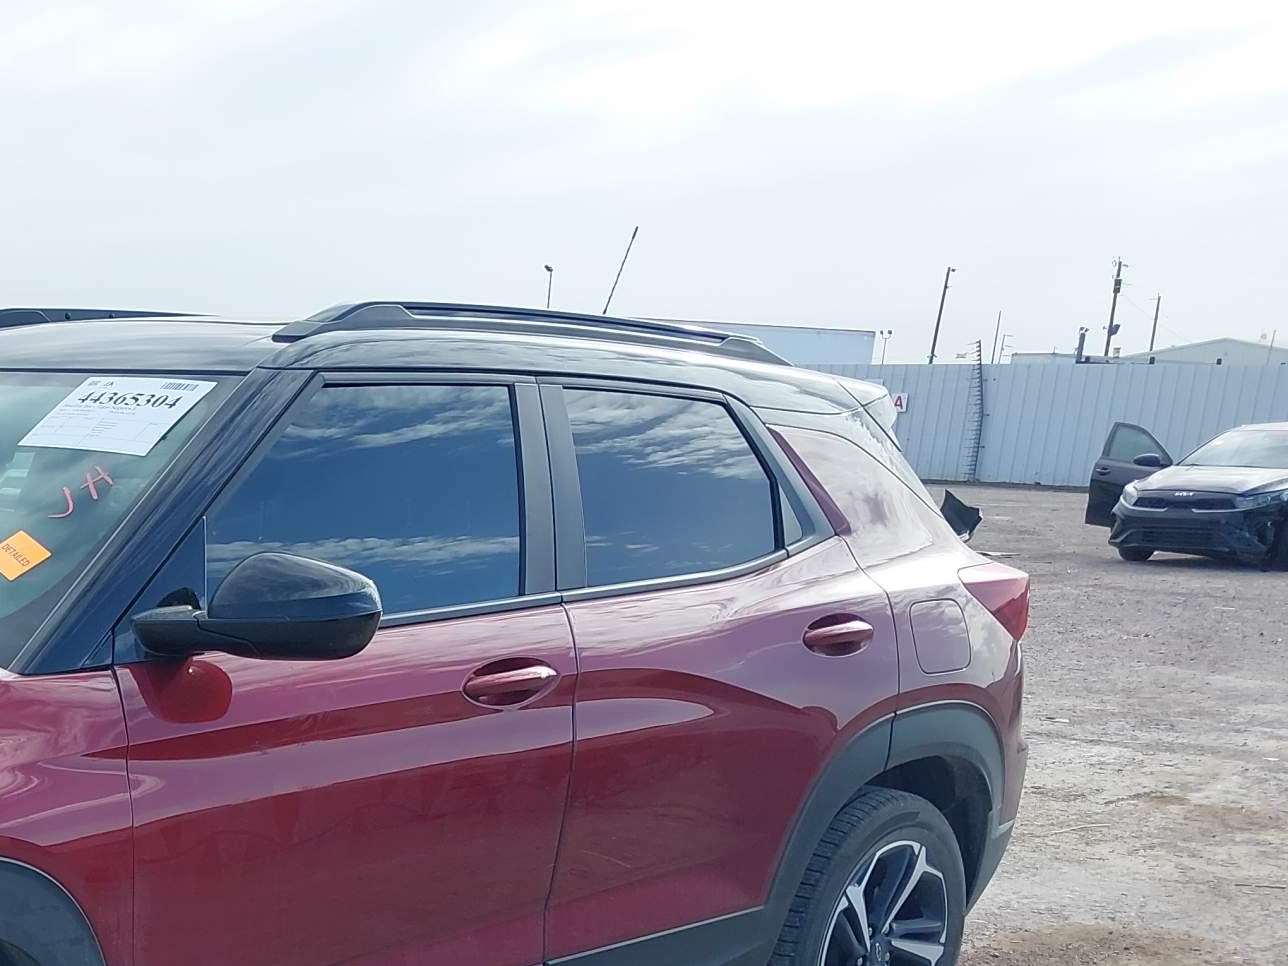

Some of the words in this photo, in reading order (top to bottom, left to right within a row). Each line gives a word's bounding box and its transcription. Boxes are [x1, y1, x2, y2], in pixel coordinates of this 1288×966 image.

[78, 391, 183, 409] 44365304
[894, 395, 903, 409] A
[1, 543, 31, 567] DETAILED
